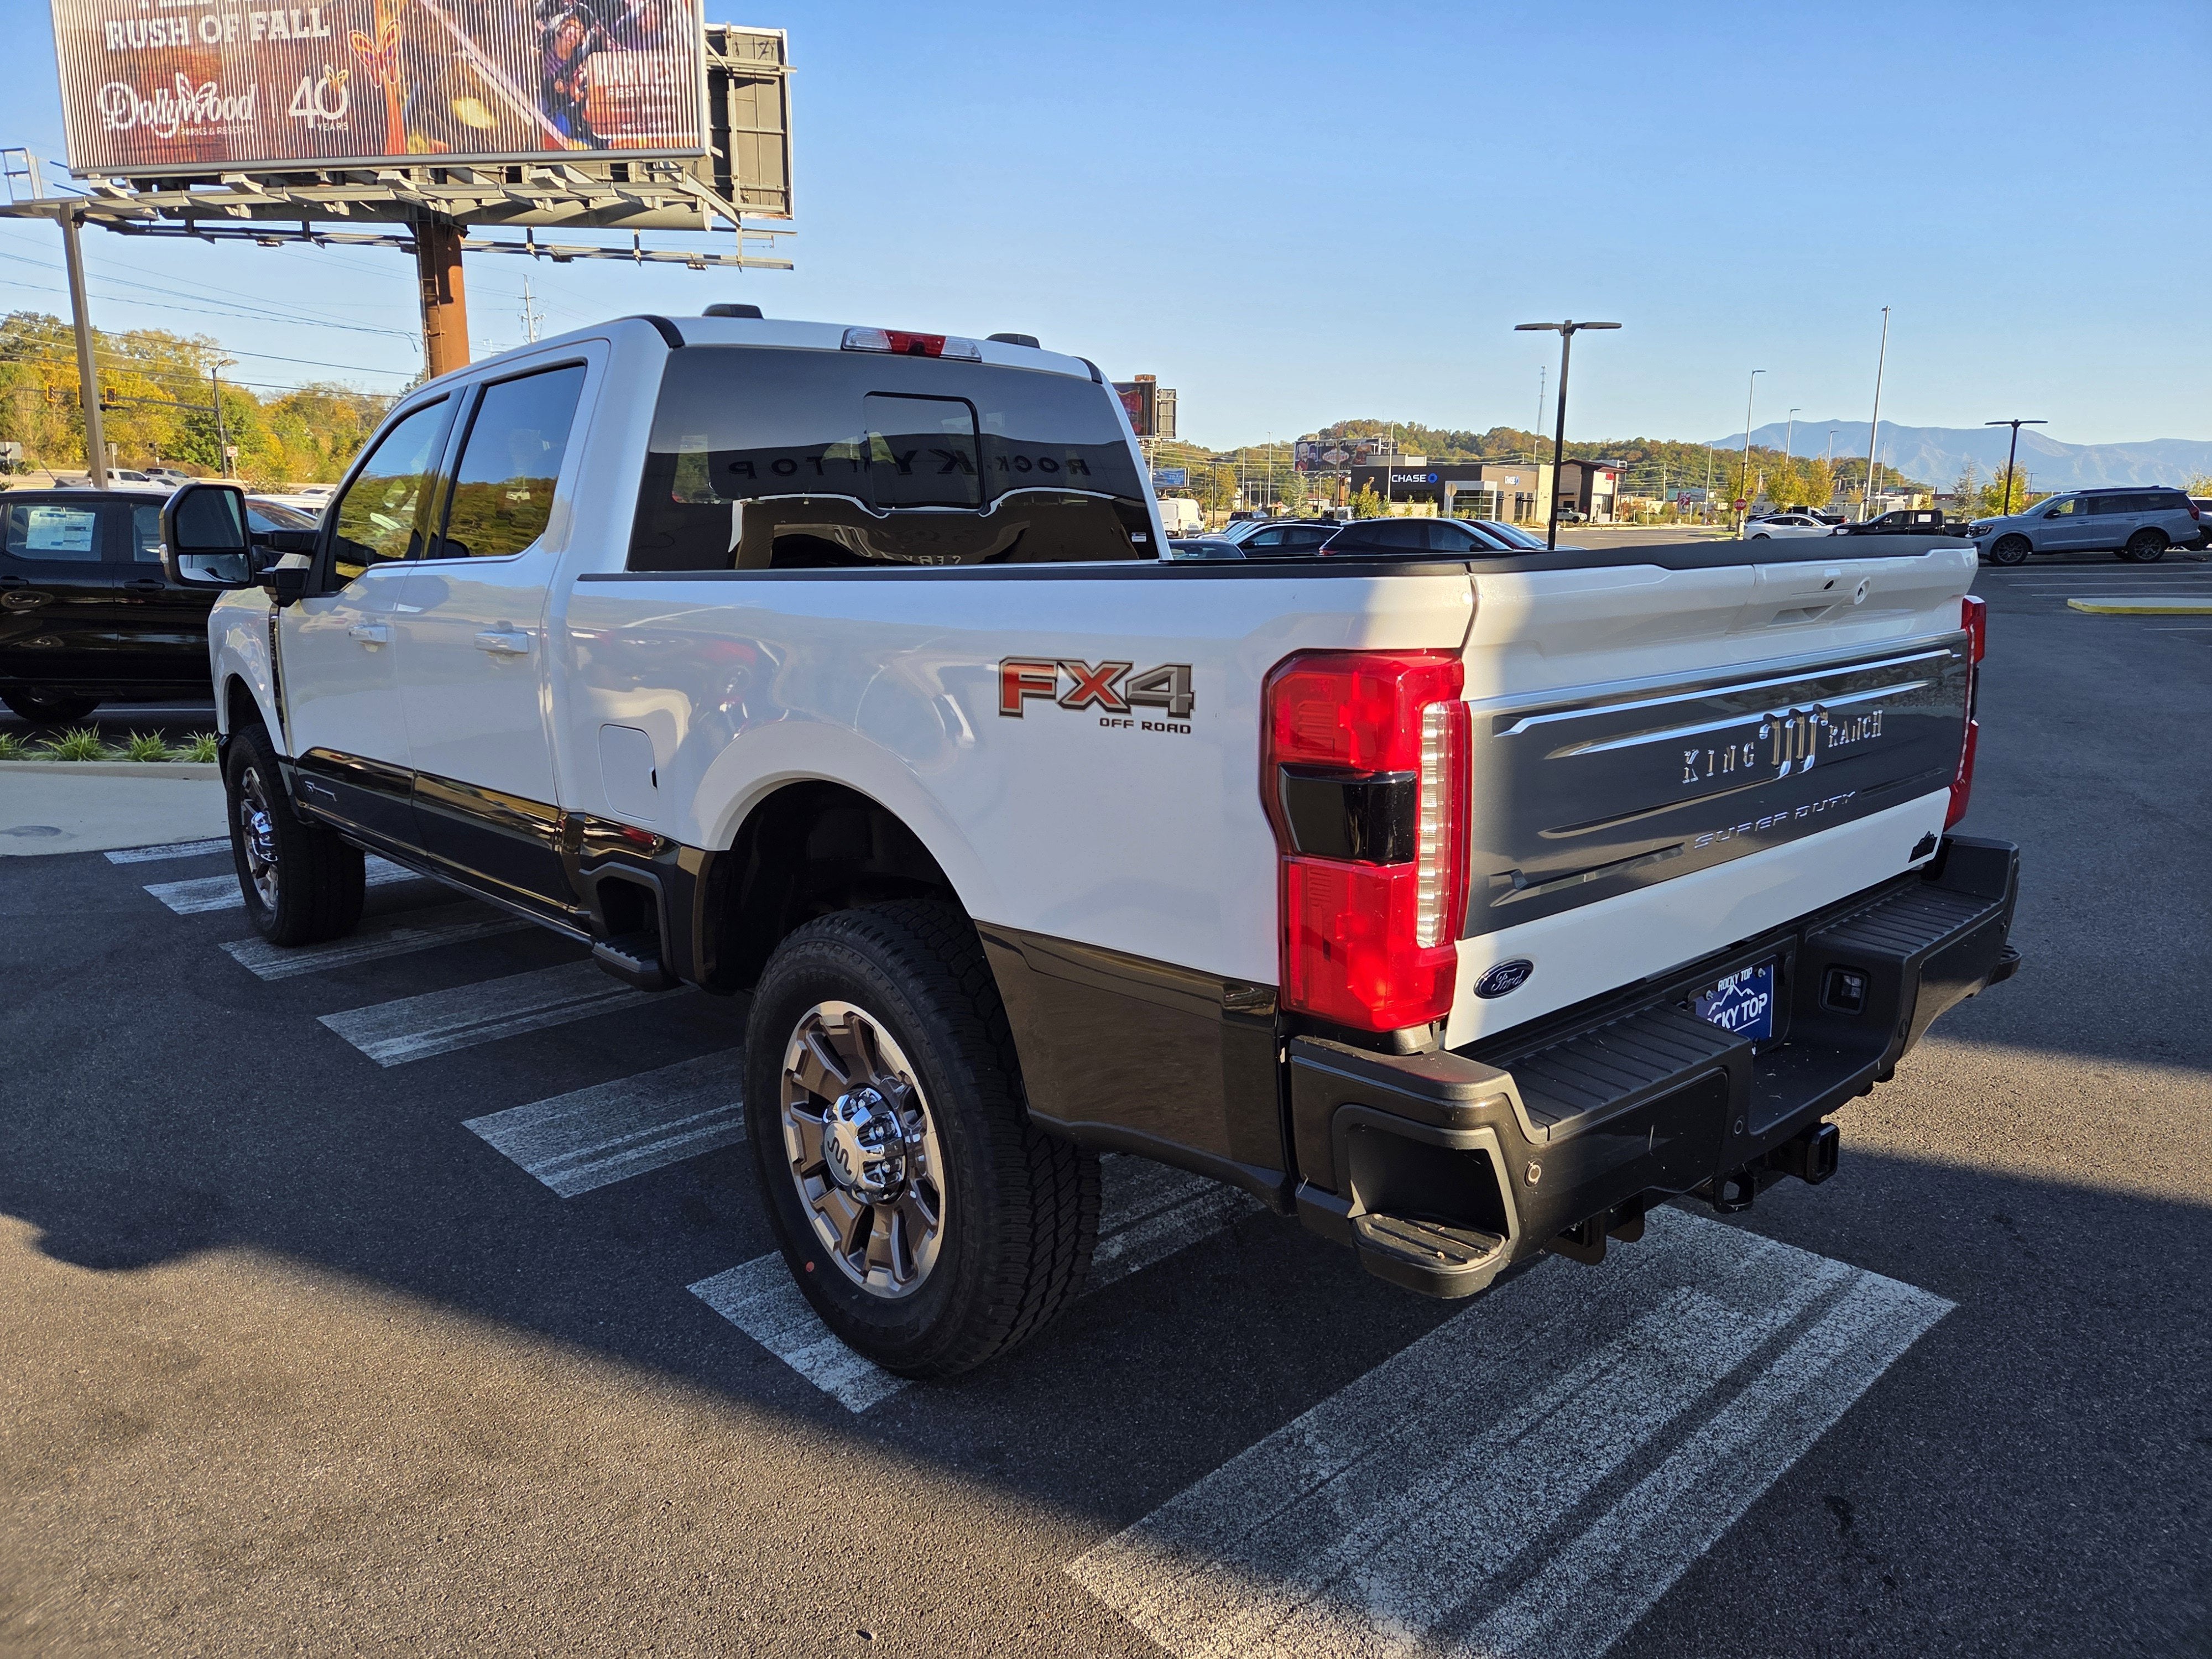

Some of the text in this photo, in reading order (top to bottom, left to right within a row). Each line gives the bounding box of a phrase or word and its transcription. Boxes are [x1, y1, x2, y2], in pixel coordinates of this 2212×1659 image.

[105, 8, 331, 51] RUSH OF FALL
[98, 72, 349, 139] Dollywood 40
[316, 122, 349, 132] YEARS
[1391, 474, 1426, 483] CHASE
[998, 655, 1196, 719] FX4
[1099, 717, 1191, 735] OFF ROAD
[1682, 709, 1883, 784] KING RANCH
[1694, 791, 1856, 849] SUPER DUTY
[1490, 968, 1525, 992] Ford
[1718, 967, 1753, 992] ROCKY TOP
[1741, 993, 1768, 1021] TOP
